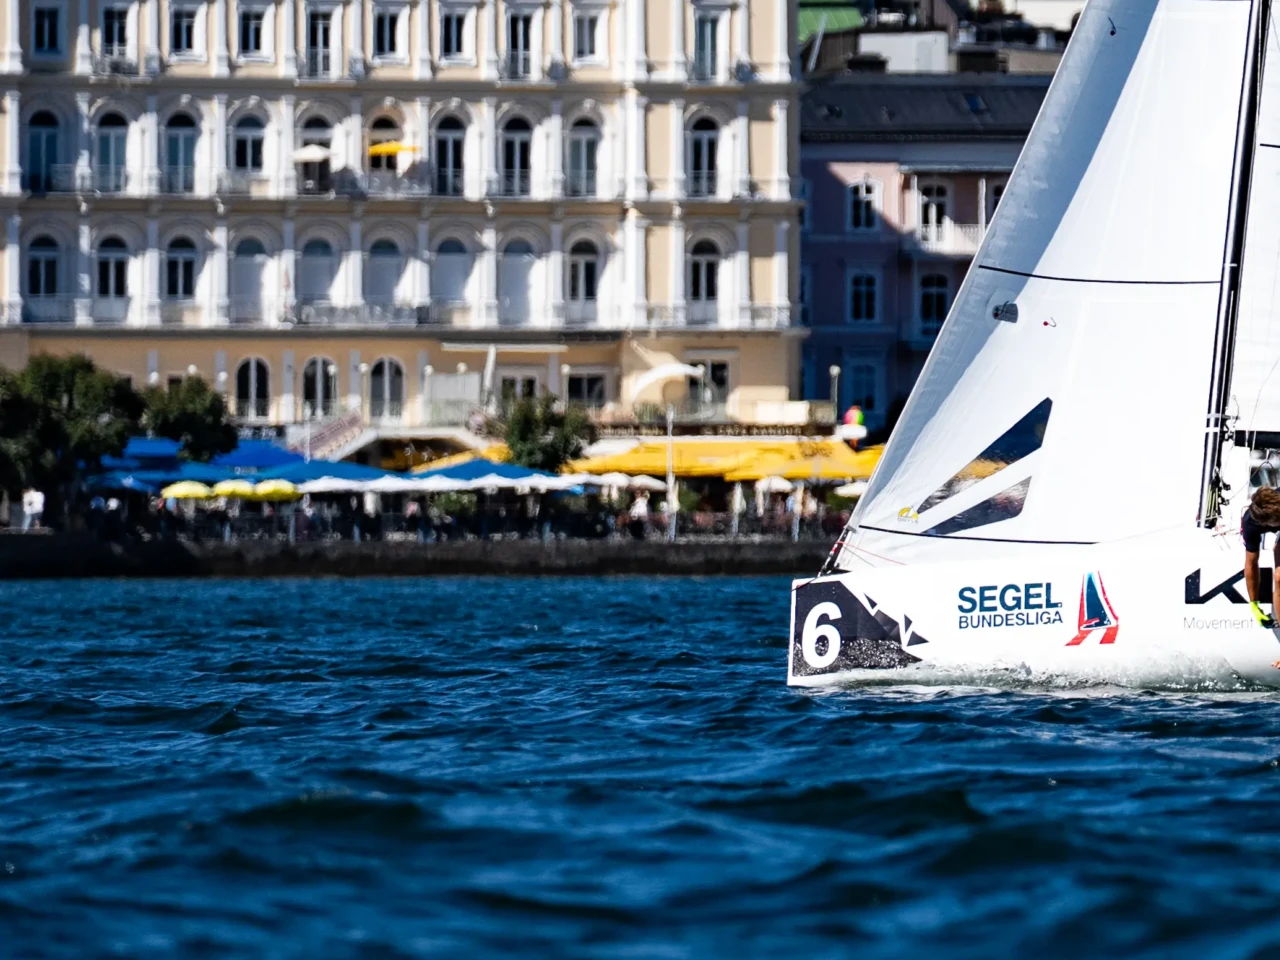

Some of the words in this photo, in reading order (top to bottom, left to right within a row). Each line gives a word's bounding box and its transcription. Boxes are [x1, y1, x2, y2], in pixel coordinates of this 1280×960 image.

[957, 582, 1063, 614] SEGEL
[958, 610, 1063, 630] BUNDESLIGA
[1183, 617, 1253, 629] Movement
[801, 601, 842, 669] 6
